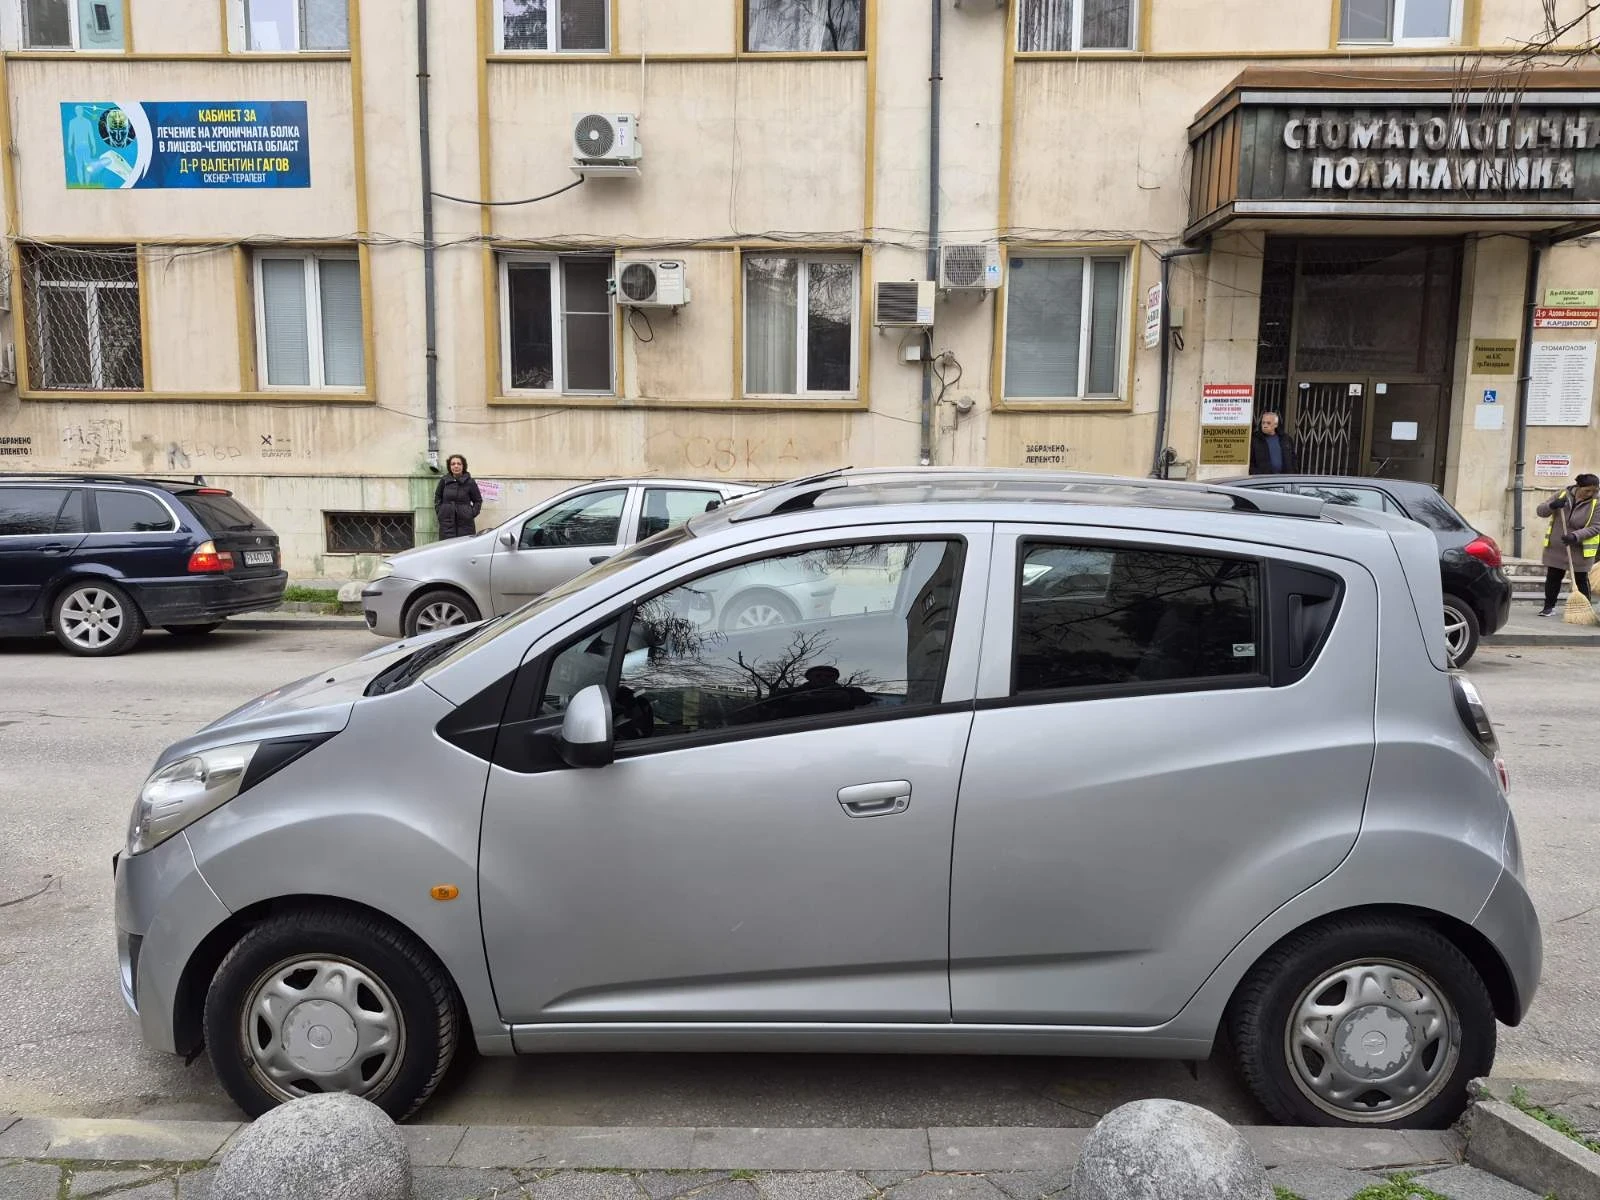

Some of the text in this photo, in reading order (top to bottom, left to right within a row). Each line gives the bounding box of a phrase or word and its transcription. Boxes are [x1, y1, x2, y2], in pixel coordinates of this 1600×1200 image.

[198, 109, 257, 122] КАБИНЕТ ЗА
[157, 125, 300, 138] ЛЕЧЕНИЕ НА ХРОНИЧНАТА БОЛКА
[159, 140, 299, 154] В ЛИЦЕВО-ЧЕЛЮСТНАТА ОБЛАСТ
[180, 158, 290, 173] Д-Р ВАЛЕНТИН ГАГОВ
[203, 172, 266, 183] СКЕНЕР-ТЕРАПЕВТ
[1311, 156, 1576, 190] ПОЛИКЛИНИКА
[1203, 428, 1248, 436] ЕНДОКРИНОЛОГ
